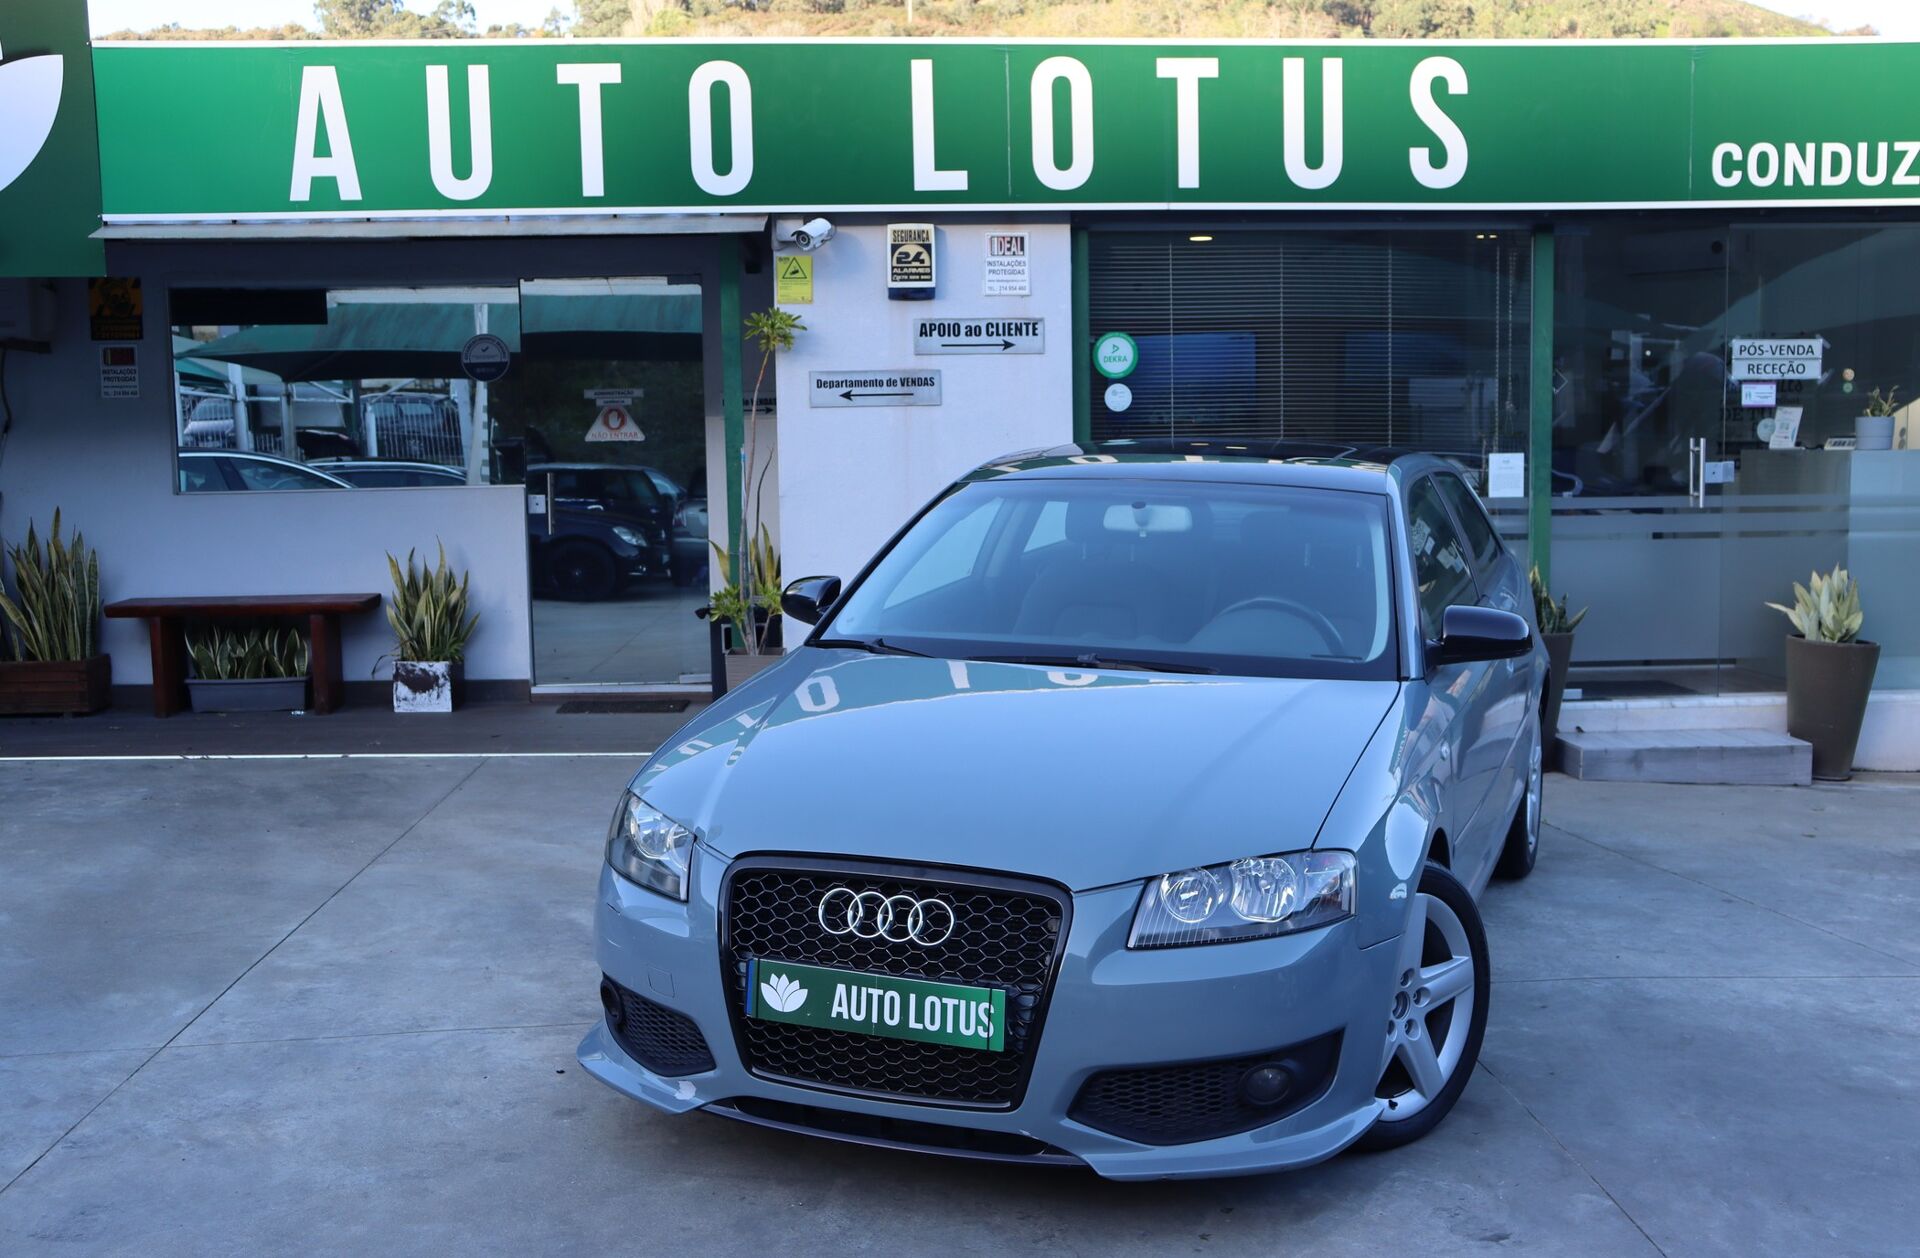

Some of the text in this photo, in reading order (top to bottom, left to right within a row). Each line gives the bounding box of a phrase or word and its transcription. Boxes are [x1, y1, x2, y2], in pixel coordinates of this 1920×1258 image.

[289, 55, 1470, 202] AUTO LOTUS
[896, 251, 925, 265] 24
[986, 259, 1026, 268] INSTALAÇÕES
[988, 268, 1025, 276] PROTEGIDAS
[919, 321, 1039, 337] APOIO ao CLIENTE
[1739, 342, 1815, 356] PÓS-VENDA
[1103, 355, 1128, 363] DEKRA
[1747, 361, 1806, 377] RECEÇÃO
[816, 377, 935, 389] Departamento de VENDAS
[830, 983, 994, 1038] AUTO LOTUS
